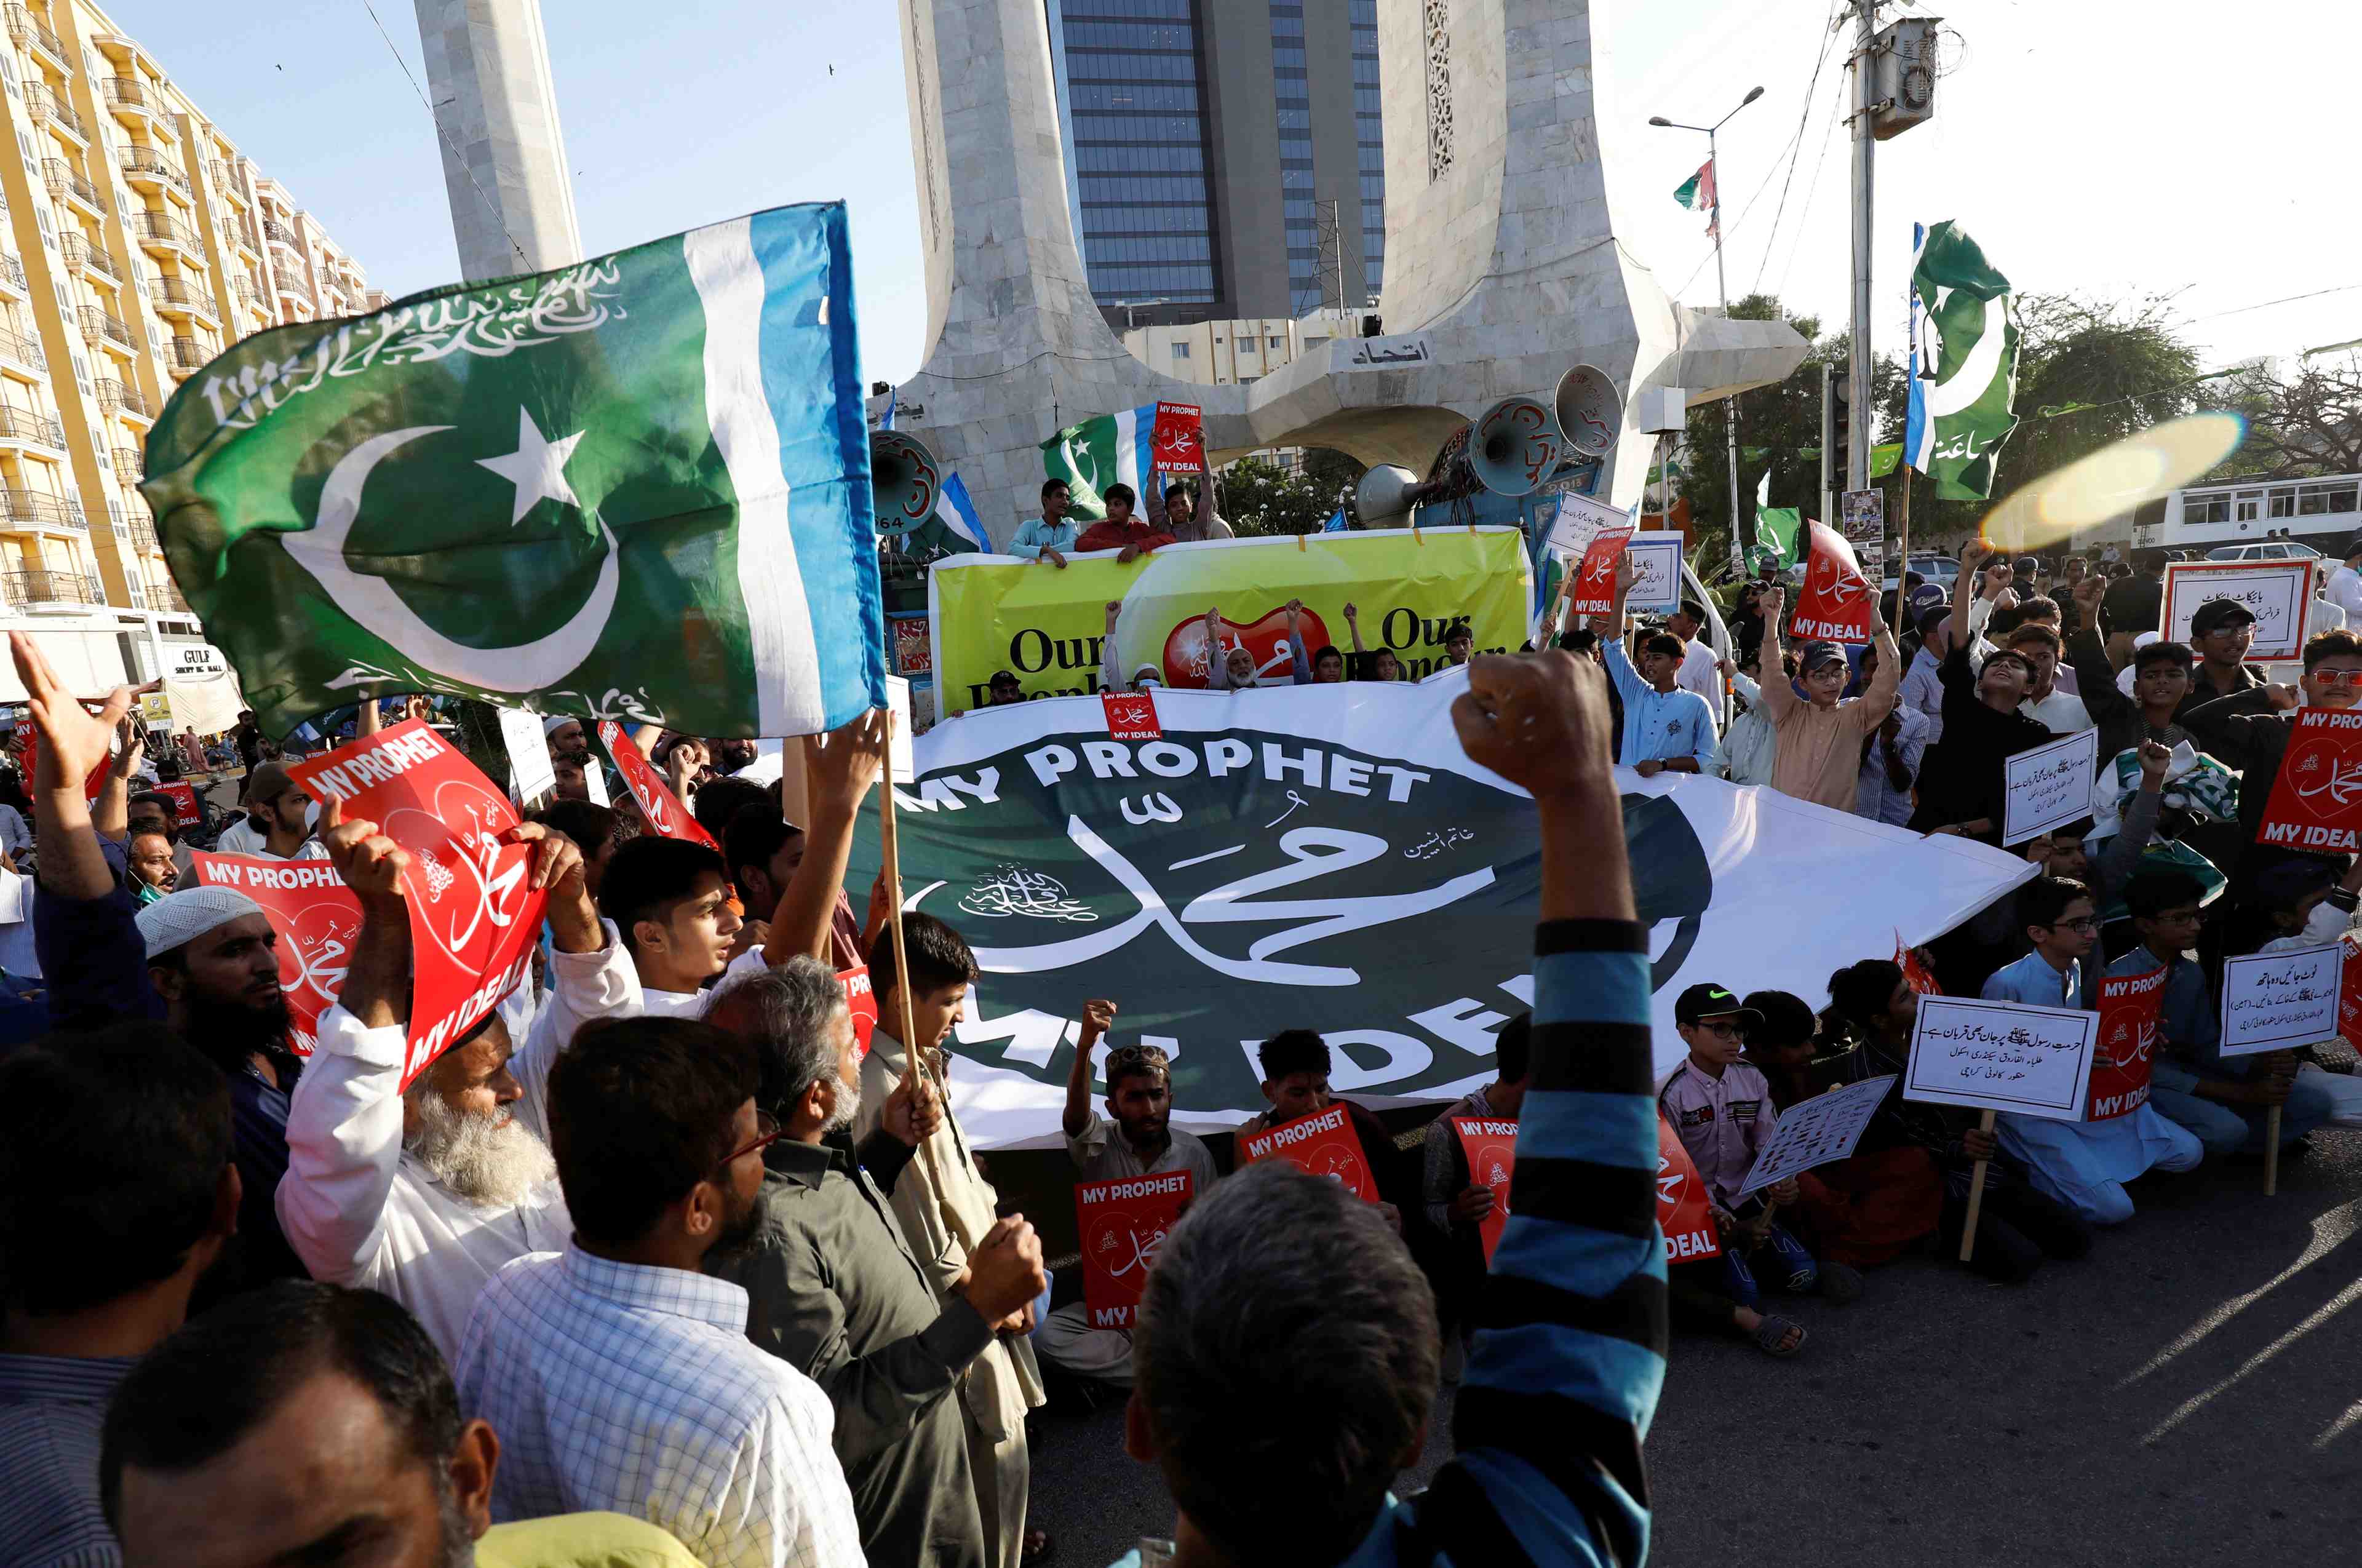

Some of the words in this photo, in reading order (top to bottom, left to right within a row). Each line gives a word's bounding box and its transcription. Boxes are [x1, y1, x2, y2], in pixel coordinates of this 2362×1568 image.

[1171, 406, 1199, 416] PROPHET
[1157, 461, 1172, 470] MY
[1173, 462, 1201, 471] IDEAL
[1605, 528, 1633, 539] PROPHET
[2232, 590, 2264, 603] بائیکاٹ
[1575, 600, 1589, 611] MY
[1589, 600, 1612, 612] IDEAL
[1794, 617, 1816, 634] MY
[1816, 621, 1866, 639] IDEAL
[185, 650, 210, 663] GULF
[1010, 629, 1105, 673] Our
[2301, 712, 2328, 727] MY
[307, 762, 359, 802] MY
[350, 727, 445, 789] PROPHET
[891, 766, 1001, 812] MY
[1024, 738, 1431, 803] PROPHET
[2264, 822, 2302, 843] MY
[2303, 826, 2360, 850] IDEA
[205, 861, 242, 886] MY
[247, 865, 346, 888] PROPH
[2104, 981, 2128, 997] MY
[406, 1015, 456, 1078] MY
[453, 955, 525, 1037] IDEAL
[1943, 1024, 1968, 1040] قربان
[1979, 1030, 1998, 1044] جان
[1997, 1035, 2006, 1047] پر
[2029, 1033, 2051, 1048] رسول
[2095, 1094, 2123, 1117] MY
[1249, 1135, 1272, 1158] MY
[1274, 1109, 1344, 1147] PROPHET
[1460, 1121, 1482, 1136] MY
[1083, 1187, 1107, 1204] MY
[1111, 1176, 1186, 1201] PROPHET
[1663, 1230, 1716, 1260] DEAL
[1096, 1306, 1127, 1327] MY
